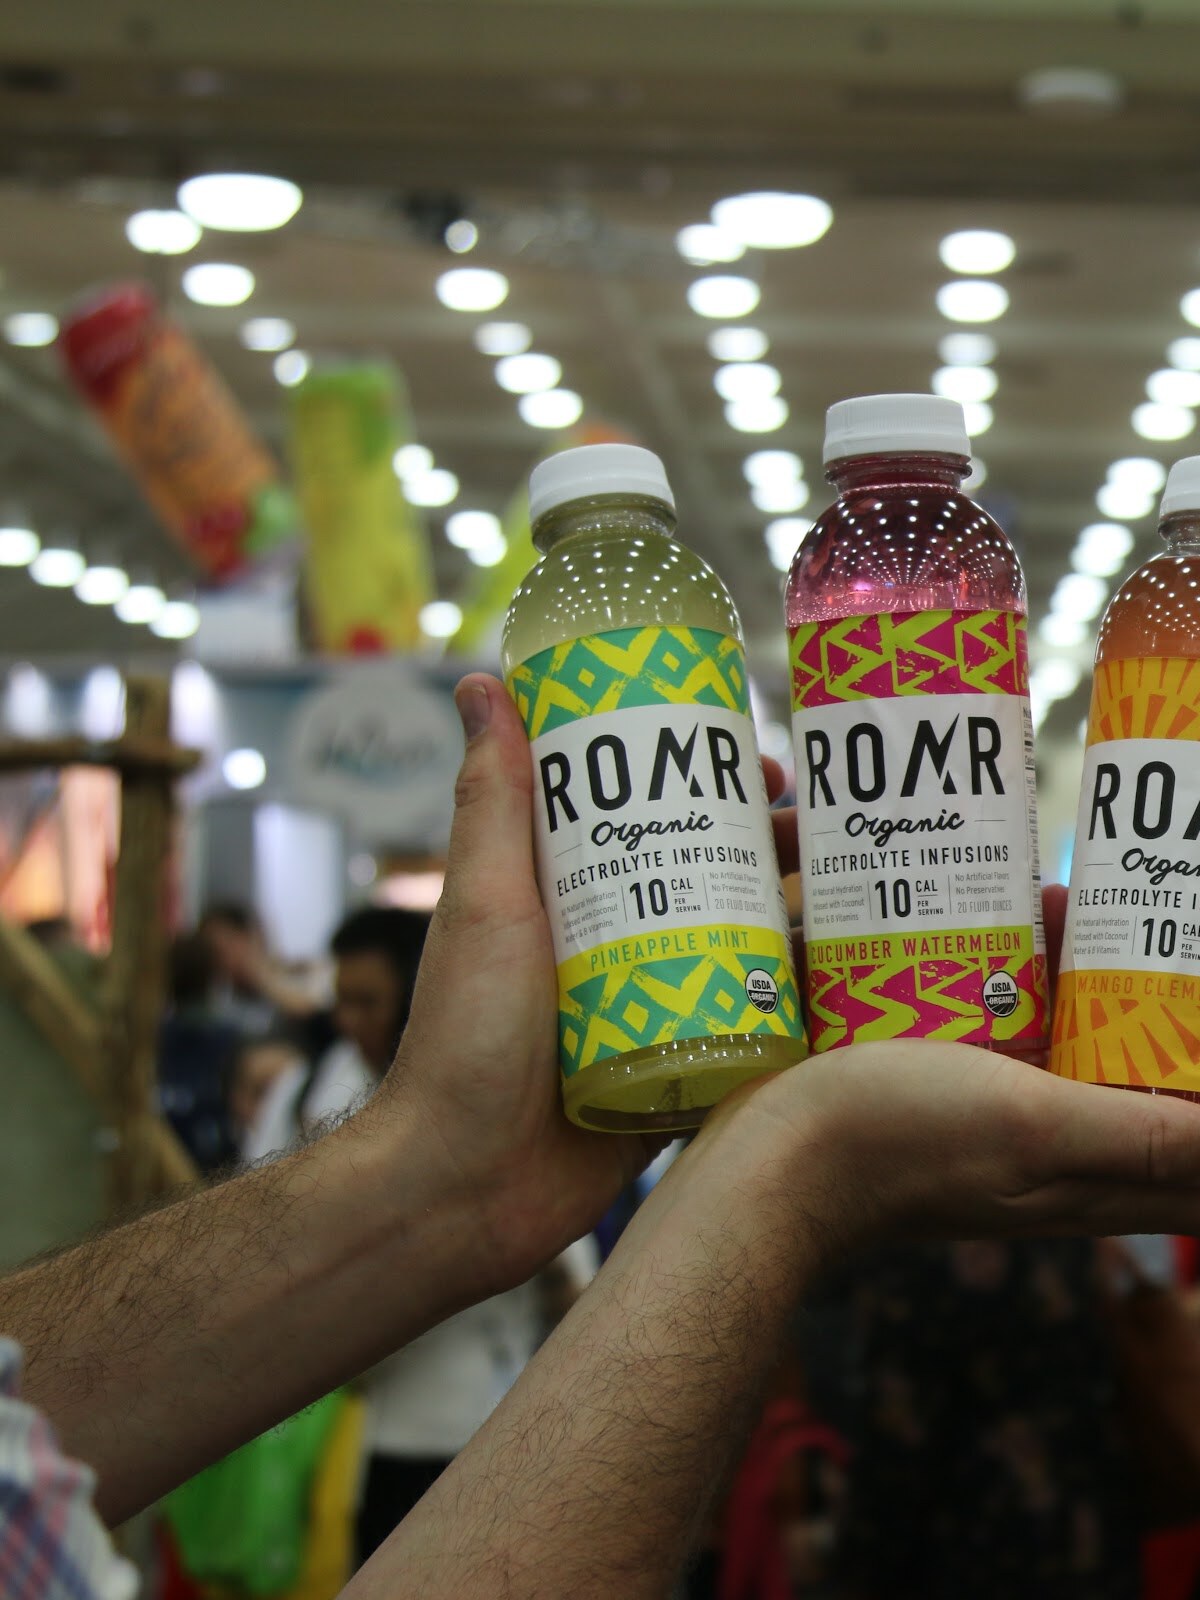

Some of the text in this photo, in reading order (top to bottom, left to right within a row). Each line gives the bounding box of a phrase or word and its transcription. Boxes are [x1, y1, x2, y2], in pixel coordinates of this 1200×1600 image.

[805, 713, 1005, 809] ROAR
[540, 721, 748, 833] ROAR
[591, 811, 714, 851] Organic
[845, 809, 965, 847] Organic
[812, 845, 1008, 876] ELECTROLYTE INFUSIONS
[557, 846, 757, 897] ELECTROLYTE INFUSIONS
[955, 873, 964, 881] No
[966, 872, 992, 881] Artificial
[671, 878, 693, 890] CAL
[712, 884, 720, 892] No
[916, 879, 938, 892] CAL
[629, 879, 669, 919] 10
[875, 879, 911, 919] 10
[1078, 888, 1182, 908] ELECTROLYTE
[715, 899, 766, 914] 20 FLUID OUNCES
[958, 900, 1012, 913] 20 FLUID OUNCES
[1102, 918, 1129, 927] Hydration
[1105, 932, 1128, 940] Coconut
[1142, 918, 1177, 957] 10
[591, 931, 749, 972] PINEAPPLE MINT
[812, 932, 1021, 964] CUCUMBER WATERMELON
[1097, 946, 1120, 954] Vitamins
[752, 979, 771, 990] USDA
[992, 983, 1011, 993] USDA
[1077, 976, 1133, 994] MANGO
[751, 993, 775, 1002] ORGANIC
[988, 996, 1014, 1005] ORGANIC
